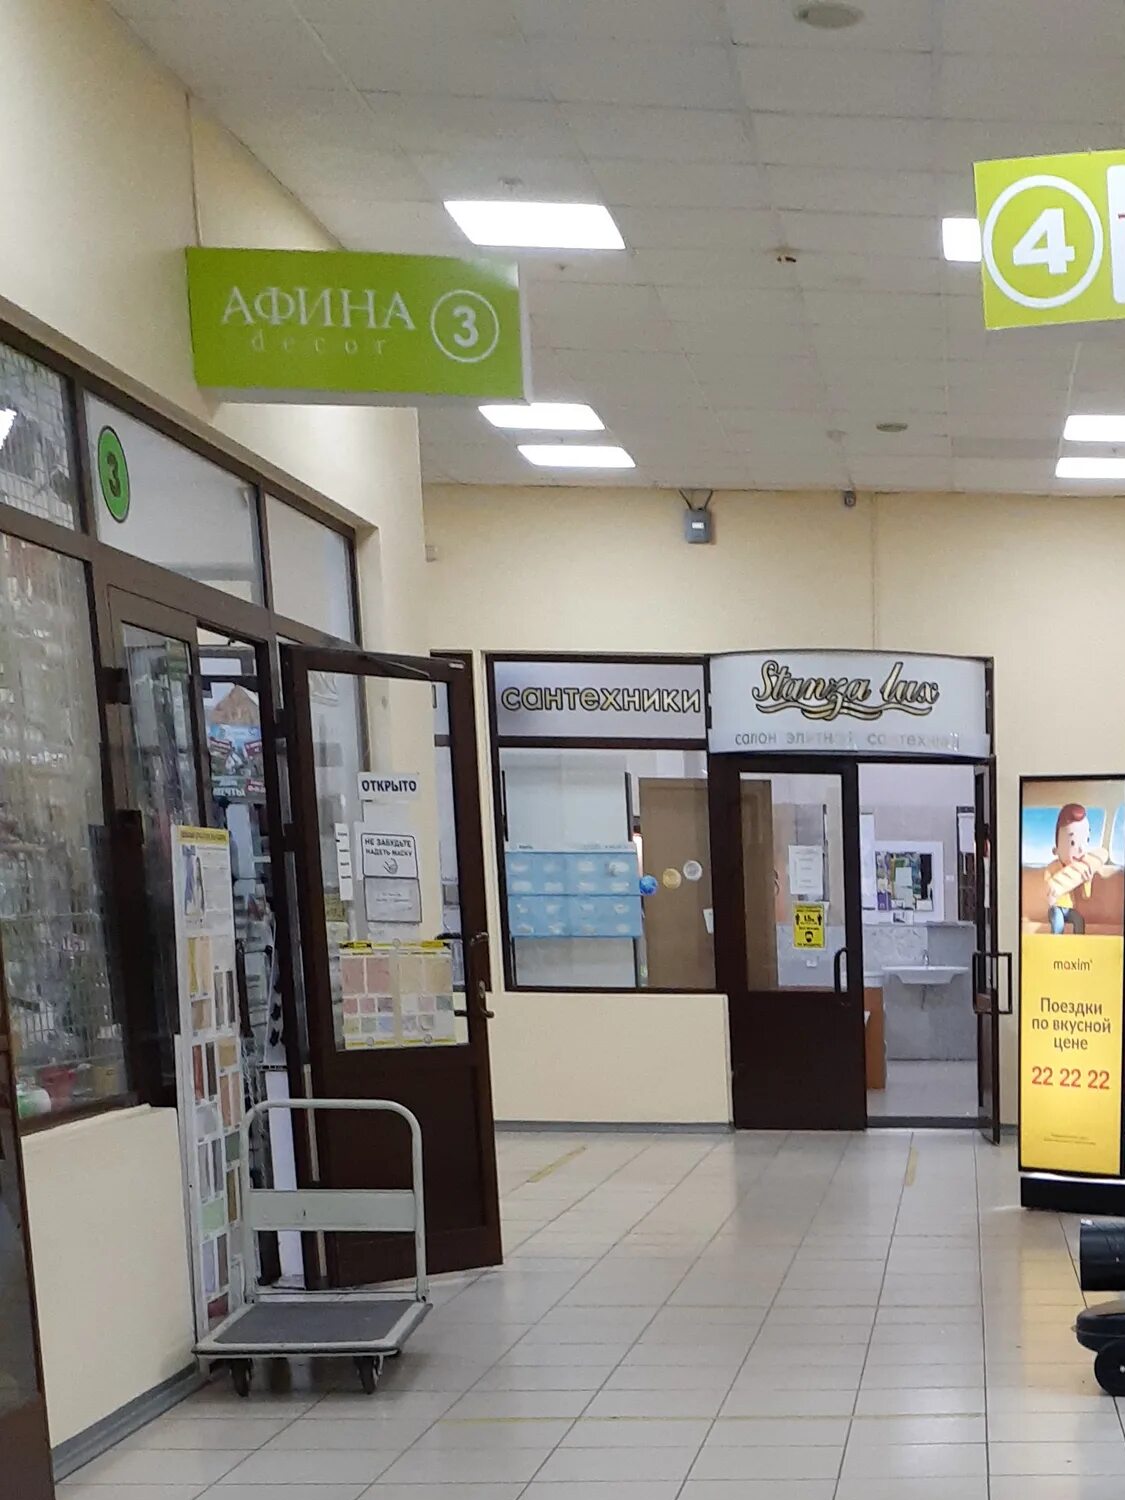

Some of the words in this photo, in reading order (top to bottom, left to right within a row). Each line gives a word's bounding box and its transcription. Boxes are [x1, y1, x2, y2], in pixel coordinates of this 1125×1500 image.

[1012, 207, 1075, 275] 4
[221, 285, 416, 331] АФИНА
[453, 304, 479, 348] 3
[251, 329, 386, 354] decor
[107, 451, 121, 498] 3
[501, 685, 702, 714] сантехники
[361, 780, 417, 792] ОТКРЫТО
[364, 838, 375, 847] НЕ
[376, 838, 412, 849] ЗАБУДЬТЕ
[1053, 957, 1091, 971] maxim
[1040, 996, 1103, 1018] Поездки
[1031, 1017, 1049, 1030] по
[1052, 1017, 1111, 1035] вкусной
[1053, 1036, 1089, 1052] цене
[1031, 1065, 1054, 1086] 22
[1059, 1067, 1082, 1089] 22
[1087, 1069, 1111, 1091] 22
